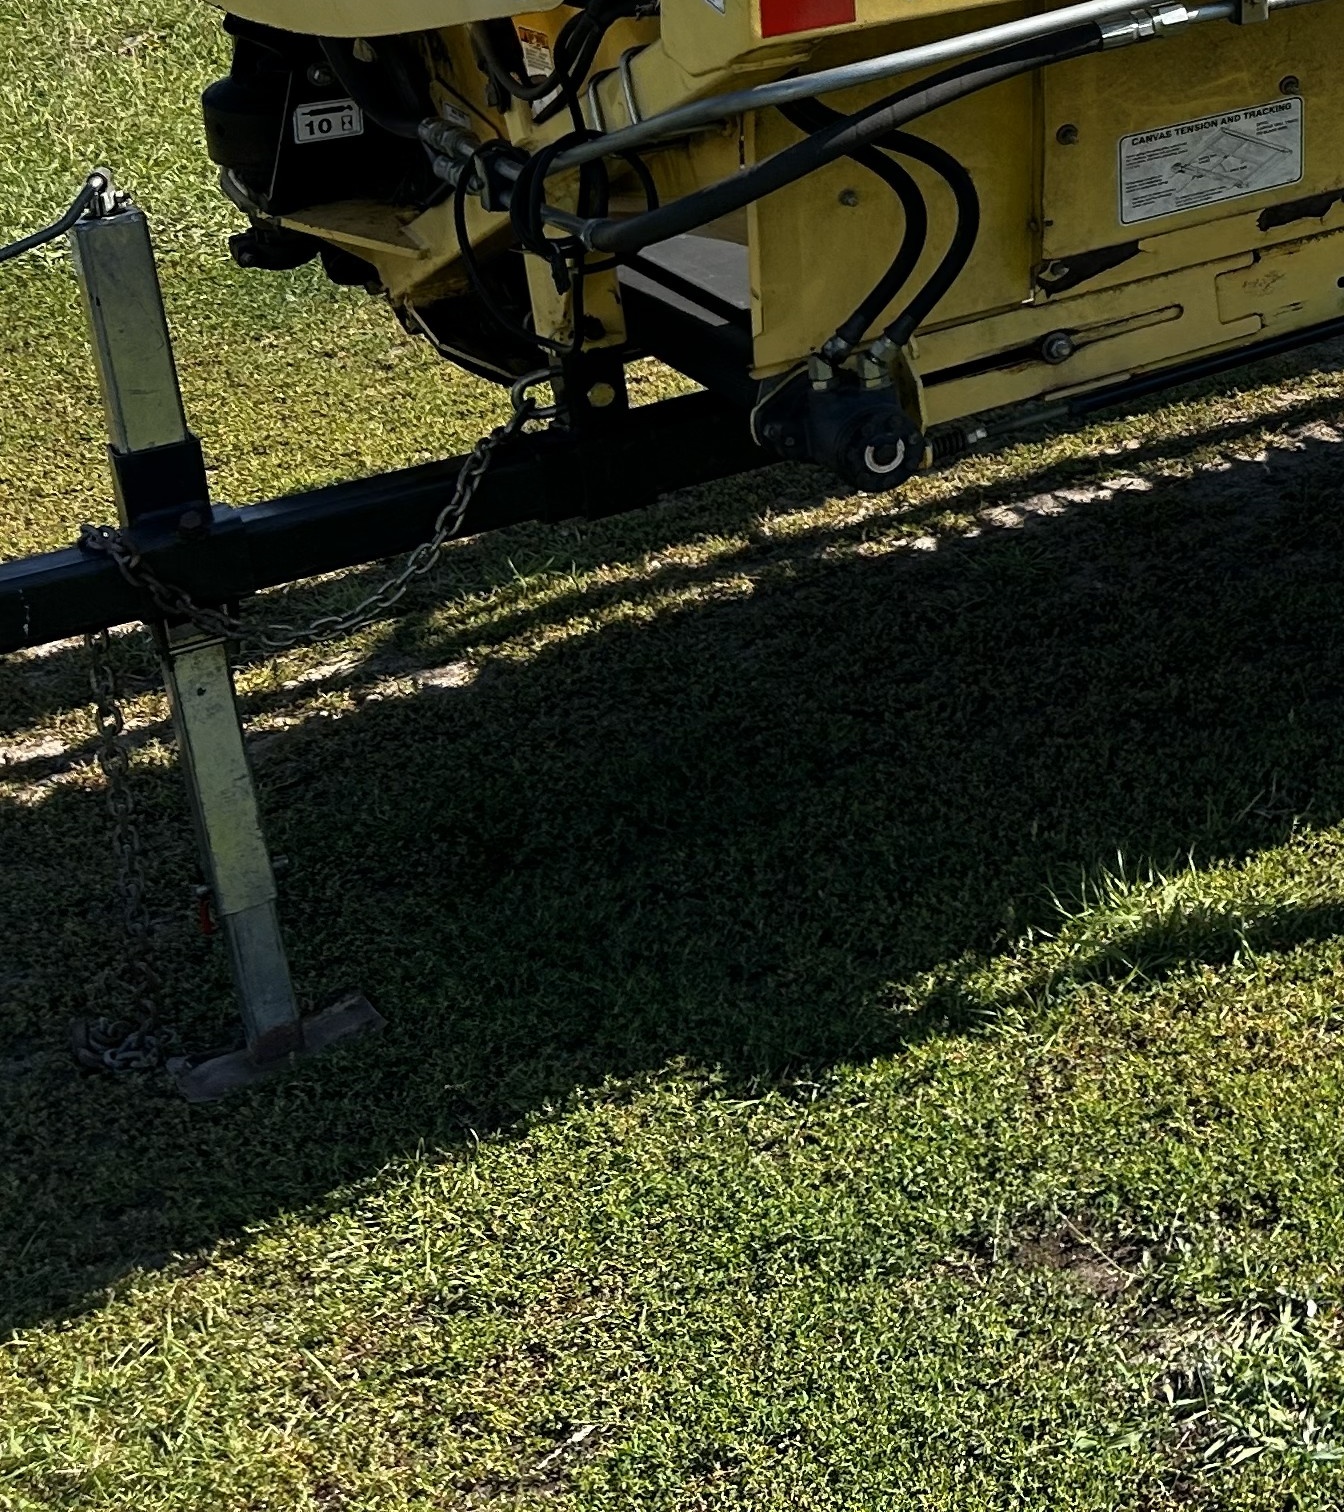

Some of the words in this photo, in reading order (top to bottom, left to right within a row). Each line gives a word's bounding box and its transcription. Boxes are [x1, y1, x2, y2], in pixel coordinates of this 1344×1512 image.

[304, 118, 332, 136] 10
[1131, 130, 1172, 146] CANVAS
[1174, 120, 1218, 137] TENSION
[1220, 114, 1241, 125] AND
[1243, 102, 1292, 119] TRACKING
